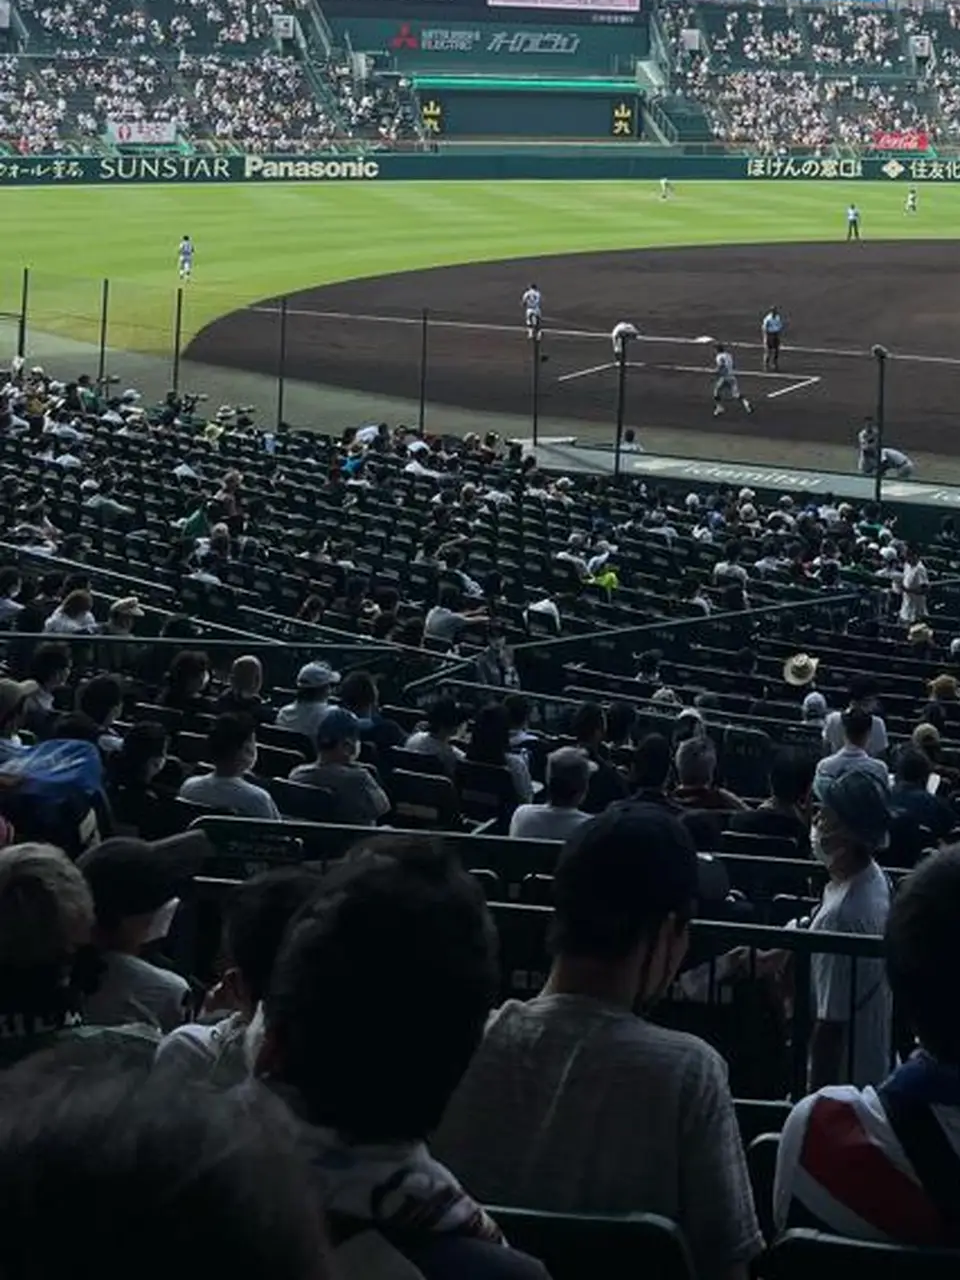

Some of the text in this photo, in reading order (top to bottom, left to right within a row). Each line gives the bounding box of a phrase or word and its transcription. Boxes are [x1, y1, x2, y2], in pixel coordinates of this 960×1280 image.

[613, 102, 632, 135] 山九
[100, 157, 230, 179] SUNSTAR
[245, 156, 380, 178] Panasonic
[748, 159, 856, 177] ほけんの窓口
